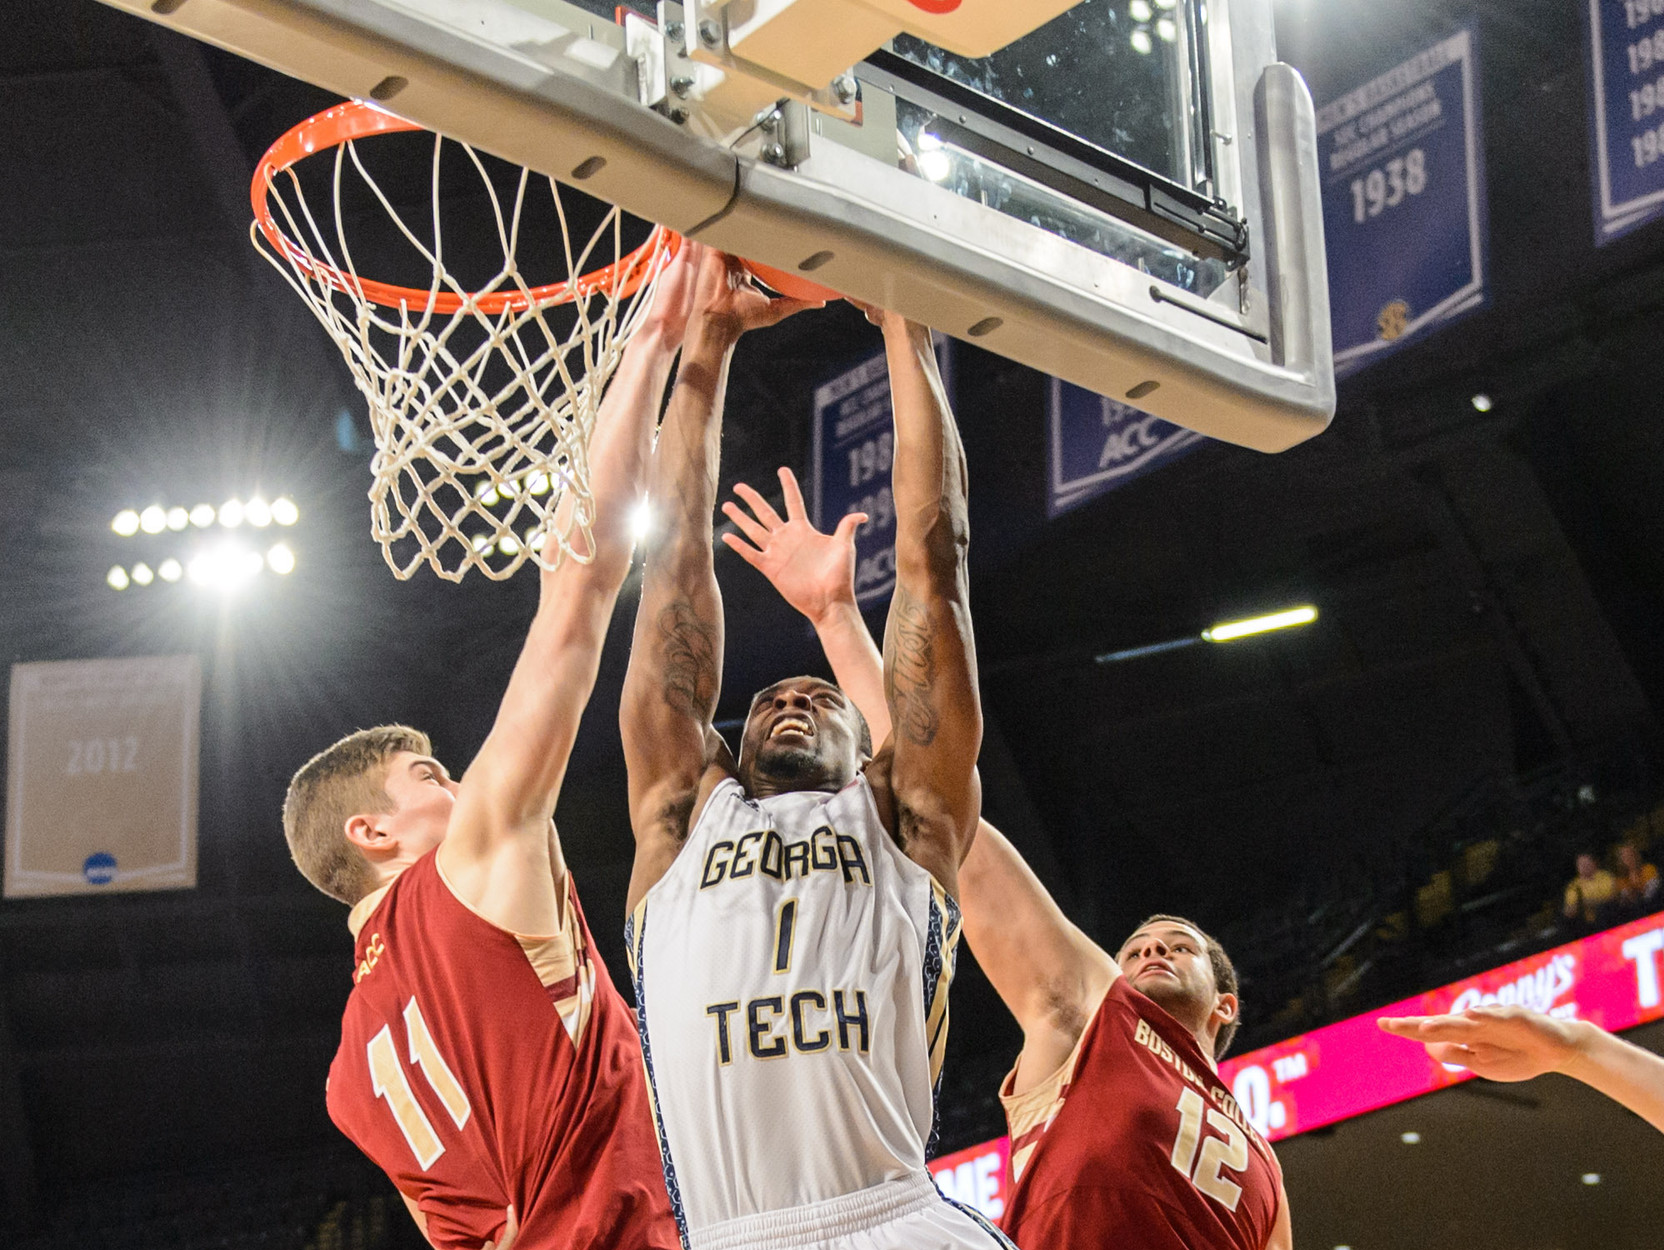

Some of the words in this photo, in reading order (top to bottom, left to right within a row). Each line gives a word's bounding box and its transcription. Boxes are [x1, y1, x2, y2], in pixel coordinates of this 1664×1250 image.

[1351, 148, 1427, 223] 1938
[1099, 415, 1159, 468] ACC
[66, 736, 138, 776] 2012
[356, 932, 385, 984] ACC
[773, 897, 798, 974] 1
[705, 988, 871, 1066] TECH
[367, 995, 472, 1172] 11
[1171, 1086, 1248, 1212] 12
